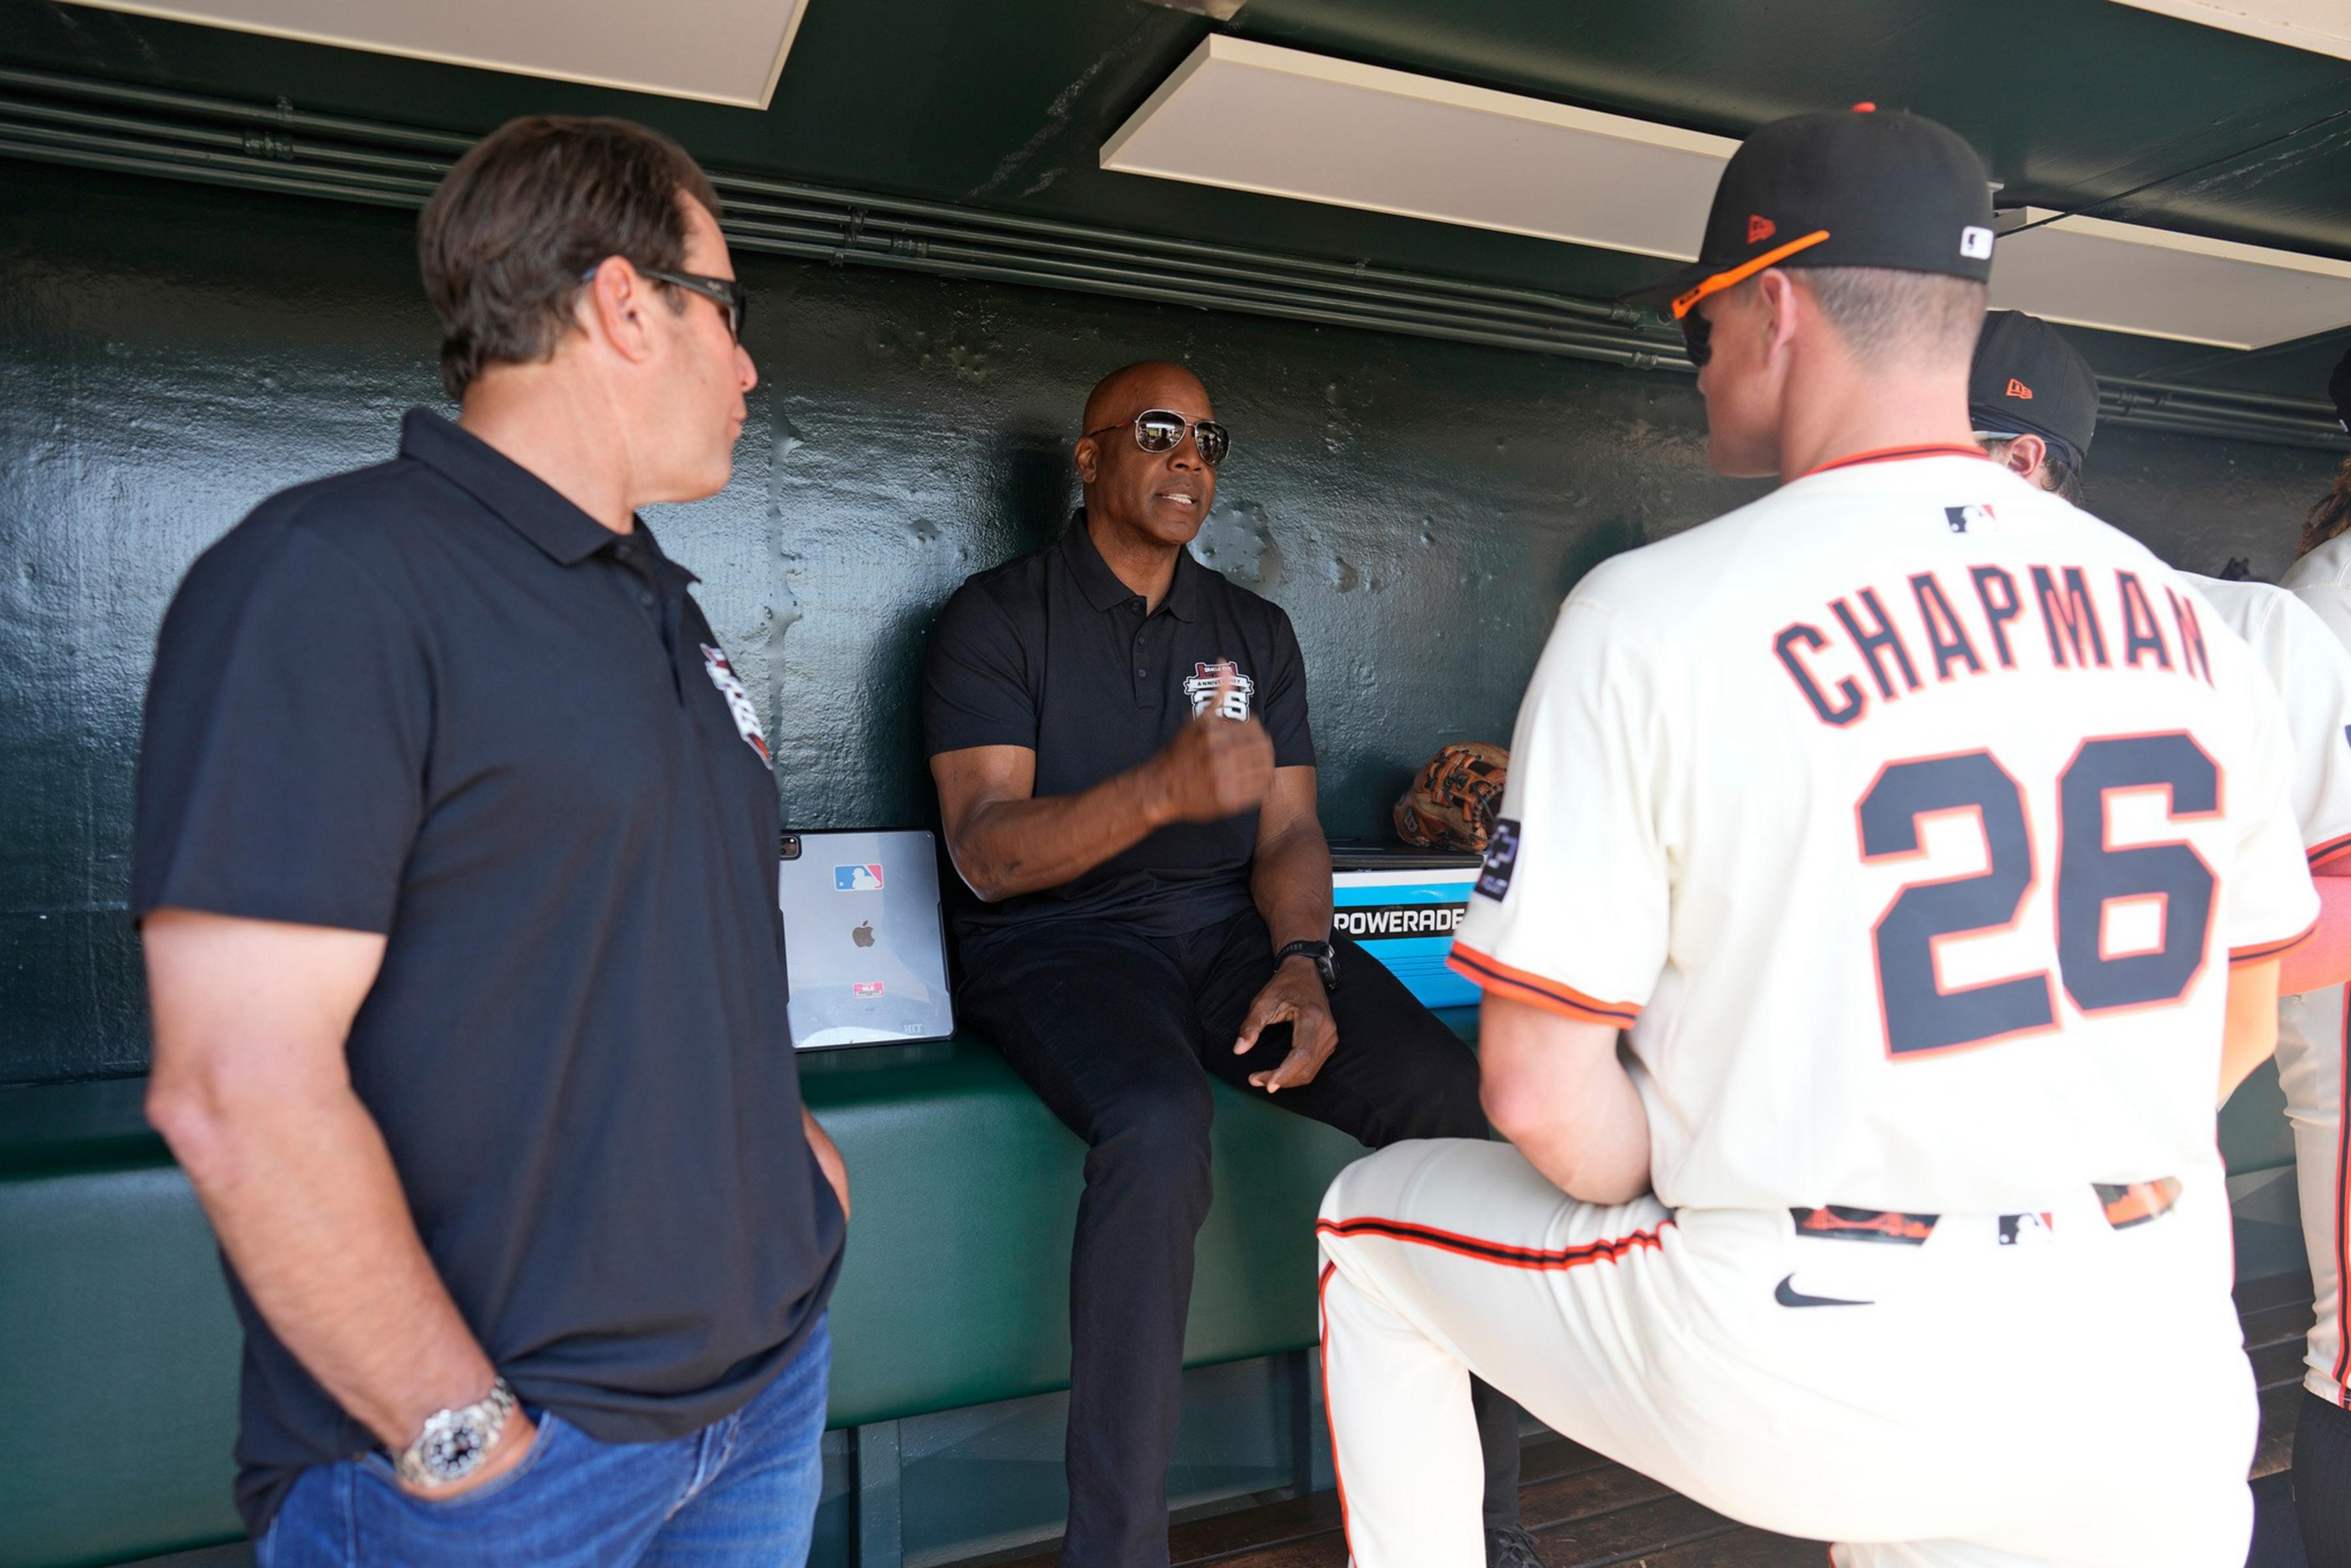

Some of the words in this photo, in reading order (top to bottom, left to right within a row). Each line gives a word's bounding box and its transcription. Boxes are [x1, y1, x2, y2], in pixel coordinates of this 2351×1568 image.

[1772, 564, 2216, 728] CHAPMAN
[1333, 908, 1465, 935] POWERADE
[1854, 729, 2224, 1061] 26
